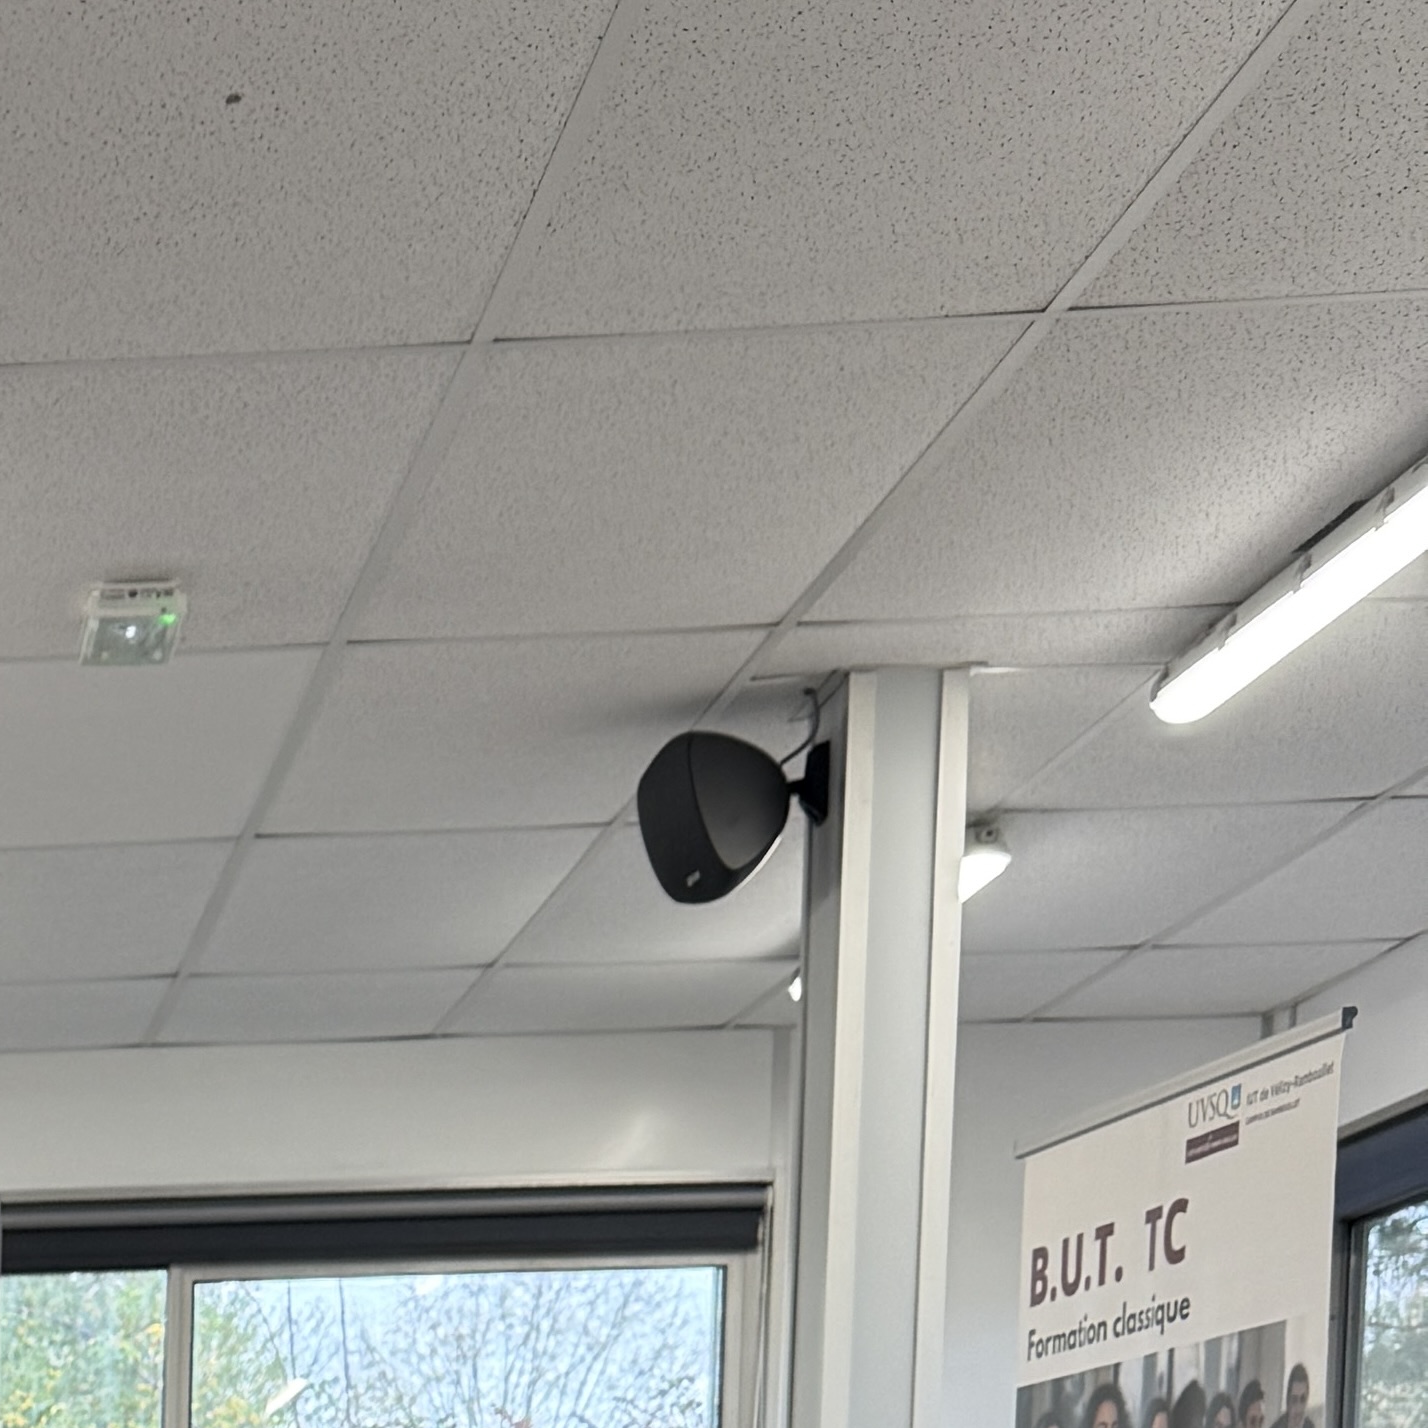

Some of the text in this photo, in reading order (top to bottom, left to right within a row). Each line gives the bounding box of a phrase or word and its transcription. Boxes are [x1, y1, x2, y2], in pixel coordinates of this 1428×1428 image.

[1188, 1089, 1237, 1127] UVSQ
[1030, 1198, 1189, 1308] B.U.T. TC
[1028, 1293, 1190, 1361] Formation classique
